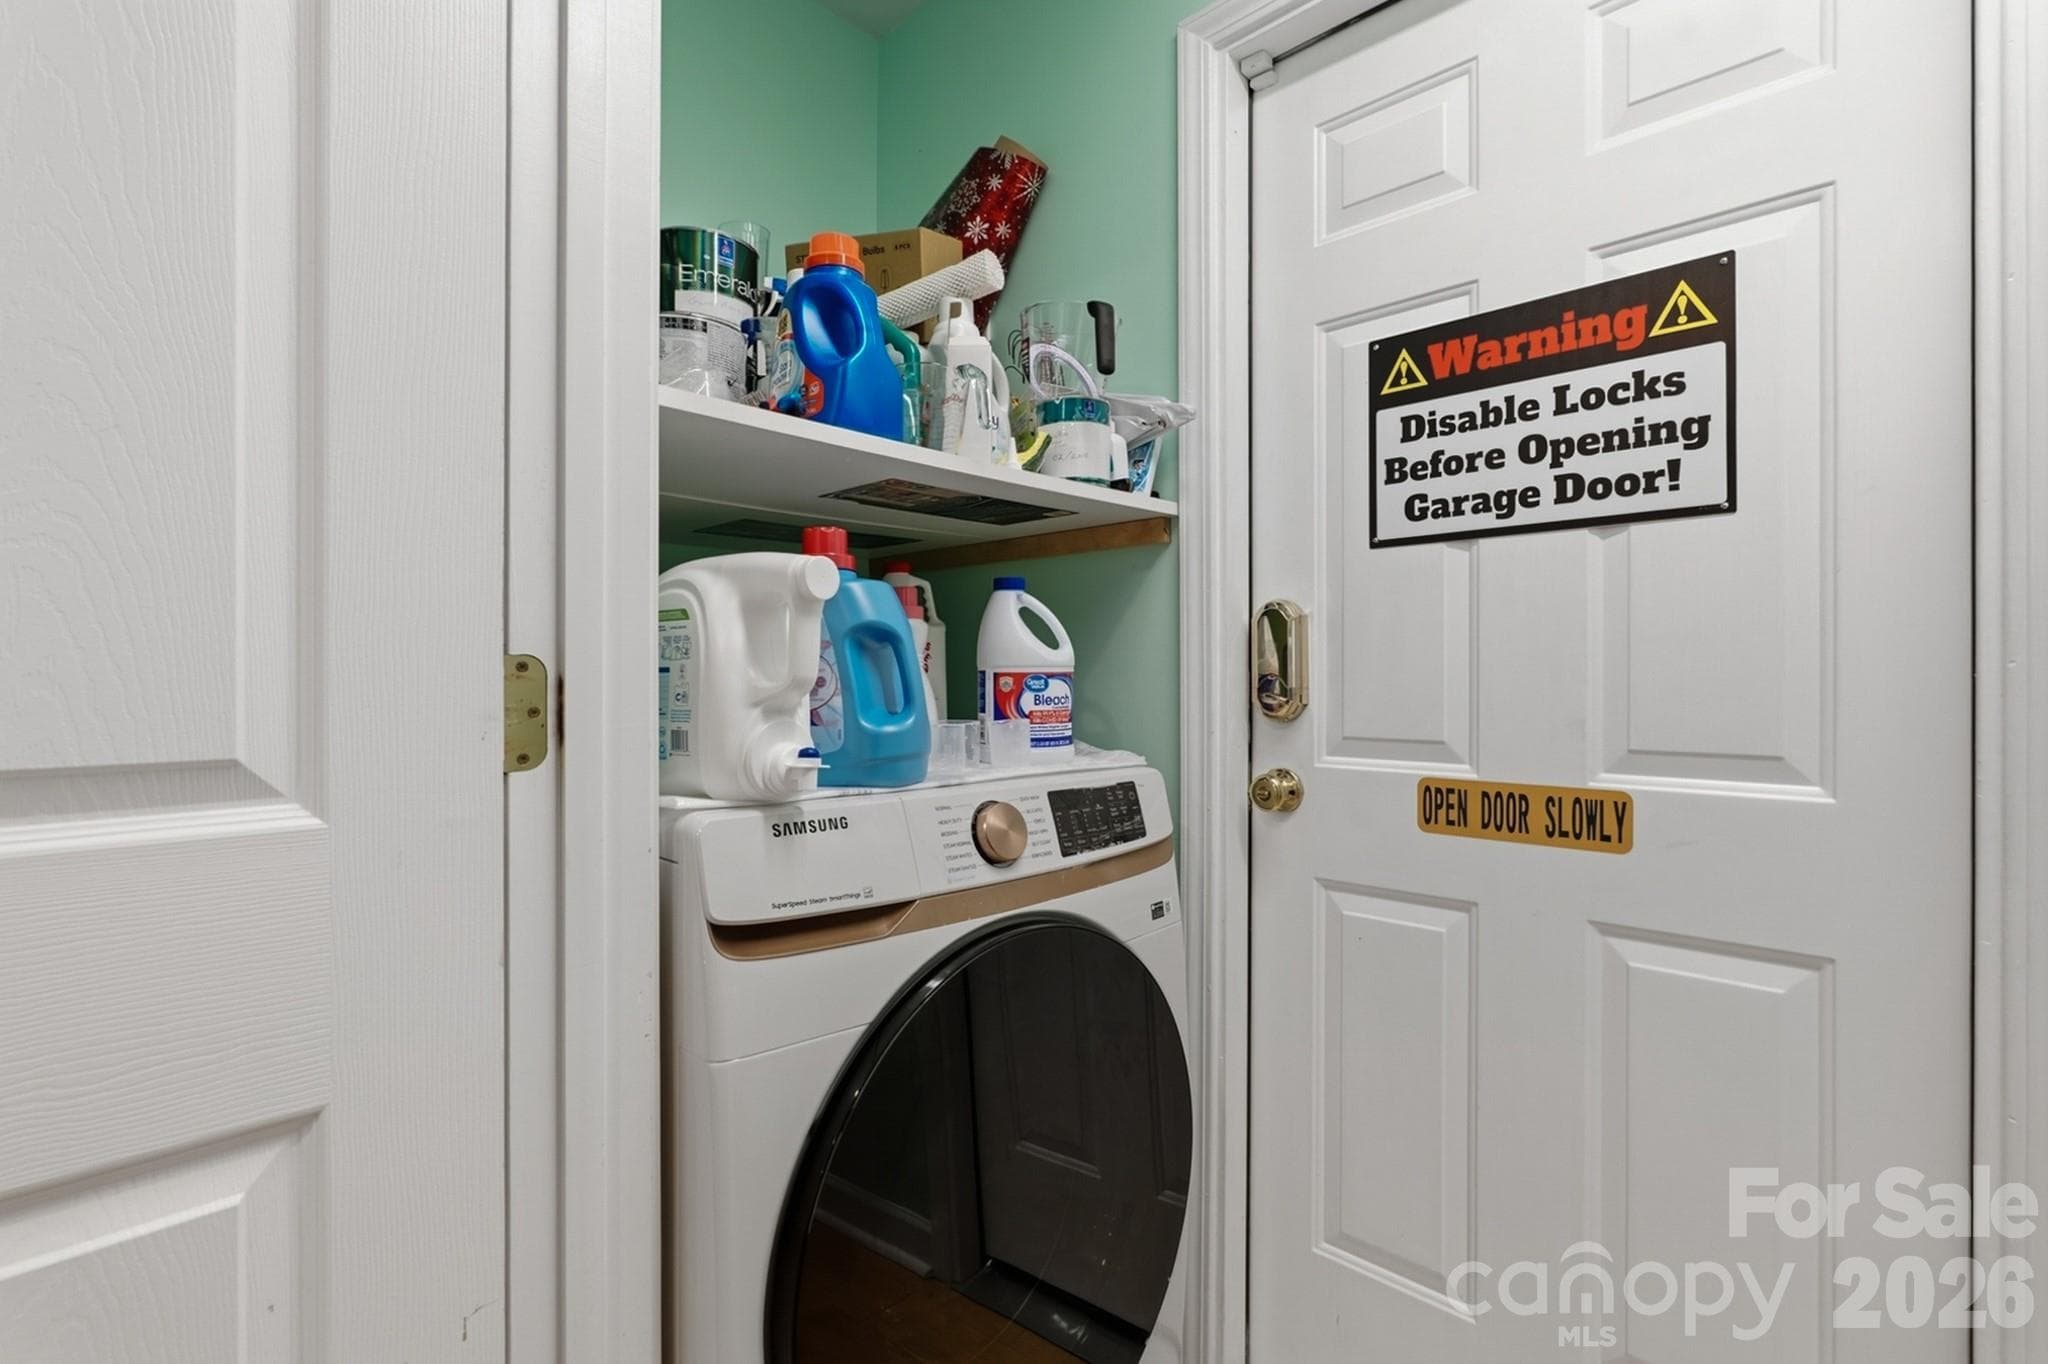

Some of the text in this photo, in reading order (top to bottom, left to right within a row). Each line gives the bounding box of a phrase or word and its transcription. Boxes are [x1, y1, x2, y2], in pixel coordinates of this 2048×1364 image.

[1427, 304, 1648, 379] Warning
[1399, 369, 1687, 444] Disable Locks
[1383, 414, 1712, 486] Before Opening
[1404, 458, 1683, 523] Garage Door!
[1034, 694, 1070, 706] Bleach
[772, 816, 849, 838] SAMSUNG
[1422, 784, 1628, 844] OPEN DOOR SLOWLY
